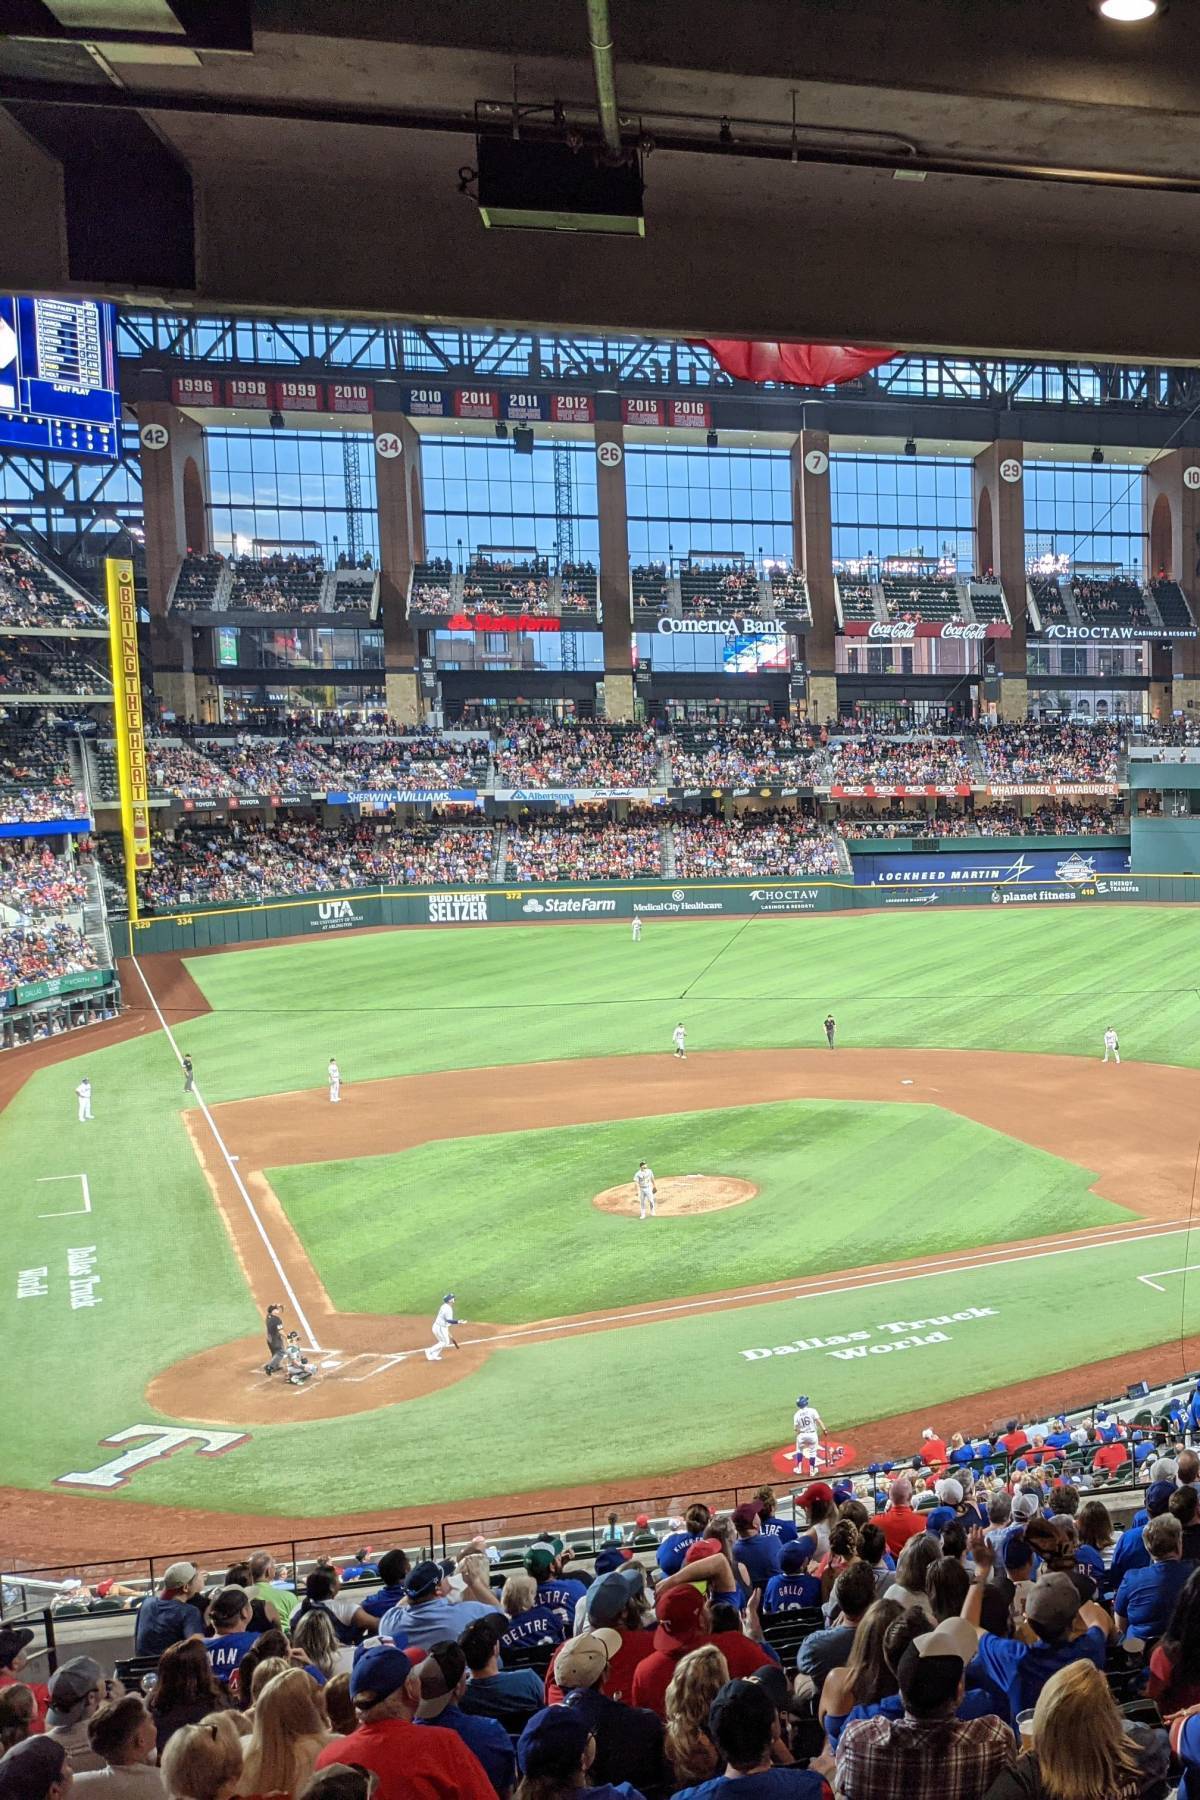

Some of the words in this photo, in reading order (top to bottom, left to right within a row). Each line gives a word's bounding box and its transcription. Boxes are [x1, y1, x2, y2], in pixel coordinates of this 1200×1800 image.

[54, 384, 70, 394] LAST
[72, 386, 90, 396] PLAY
[178, 379, 212, 392] 1996
[232, 381, 266, 394] 1998
[282, 383, 316, 397] 1999
[335, 386, 366, 399] 2010
[410, 390, 441, 403] 2010
[462, 392, 490, 405] 2011
[510, 394, 538, 407] 2011
[558, 396, 588, 409] 2012
[628, 400, 657, 413] 2015
[674, 402, 704, 414] 2016
[143, 428, 164, 444] 42
[378, 438, 399, 452] 34
[600, 447, 619, 462] 26
[812, 454, 821, 470] 7
[1002, 464, 1020, 477] 29
[1188, 472, 1200, 484] 10
[121, 588, 136, 672] BRING
[744, 618, 786, 634] Bank
[868, 621, 916, 638] Coca-Cola
[940, 622, 988, 639] Coca-Cola
[1055, 625, 1134, 639] CHOCTAW
[126, 678, 139, 727] THE
[130, 734, 144, 800] HEAT
[528, 790, 574, 801] Albertsons
[591, 790, 607, 798] Tom
[608, 788, 633, 798] Thumb
[843, 786, 865, 794] DEX
[874, 786, 896, 794] DEX
[904, 786, 926, 794] DEX
[935, 786, 957, 794] DEX
[990, 785, 1050, 795] WHATABURGER
[1055, 784, 1114, 794] WHATABURGER
[879, 870, 946, 882] LOCKHEED
[950, 870, 1000, 880] MARTIN
[506, 892, 522, 900] 372
[756, 889, 819, 900] CHOCTAW
[1003, 893, 1038, 904] planet
[1040, 890, 1076, 901] fitness
[319, 901, 354, 919] UTA
[430, 902, 488, 922] SELTZER
[664, 903, 680, 912] City
[682, 902, 722, 910] Healthcare
[16, 1266, 48, 1299] World
[738, 1330, 871, 1361] Dallas
[877, 1308, 1000, 1334] Truck
[826, 1331, 952, 1360] World
[801, 1416, 810, 1426] 16
[52, 1423, 252, 1492] T
[778, 1585, 804, 1596] GALLO
[502, 1619, 548, 1646] BELTRE
[206, 1648, 238, 1666] YAN
